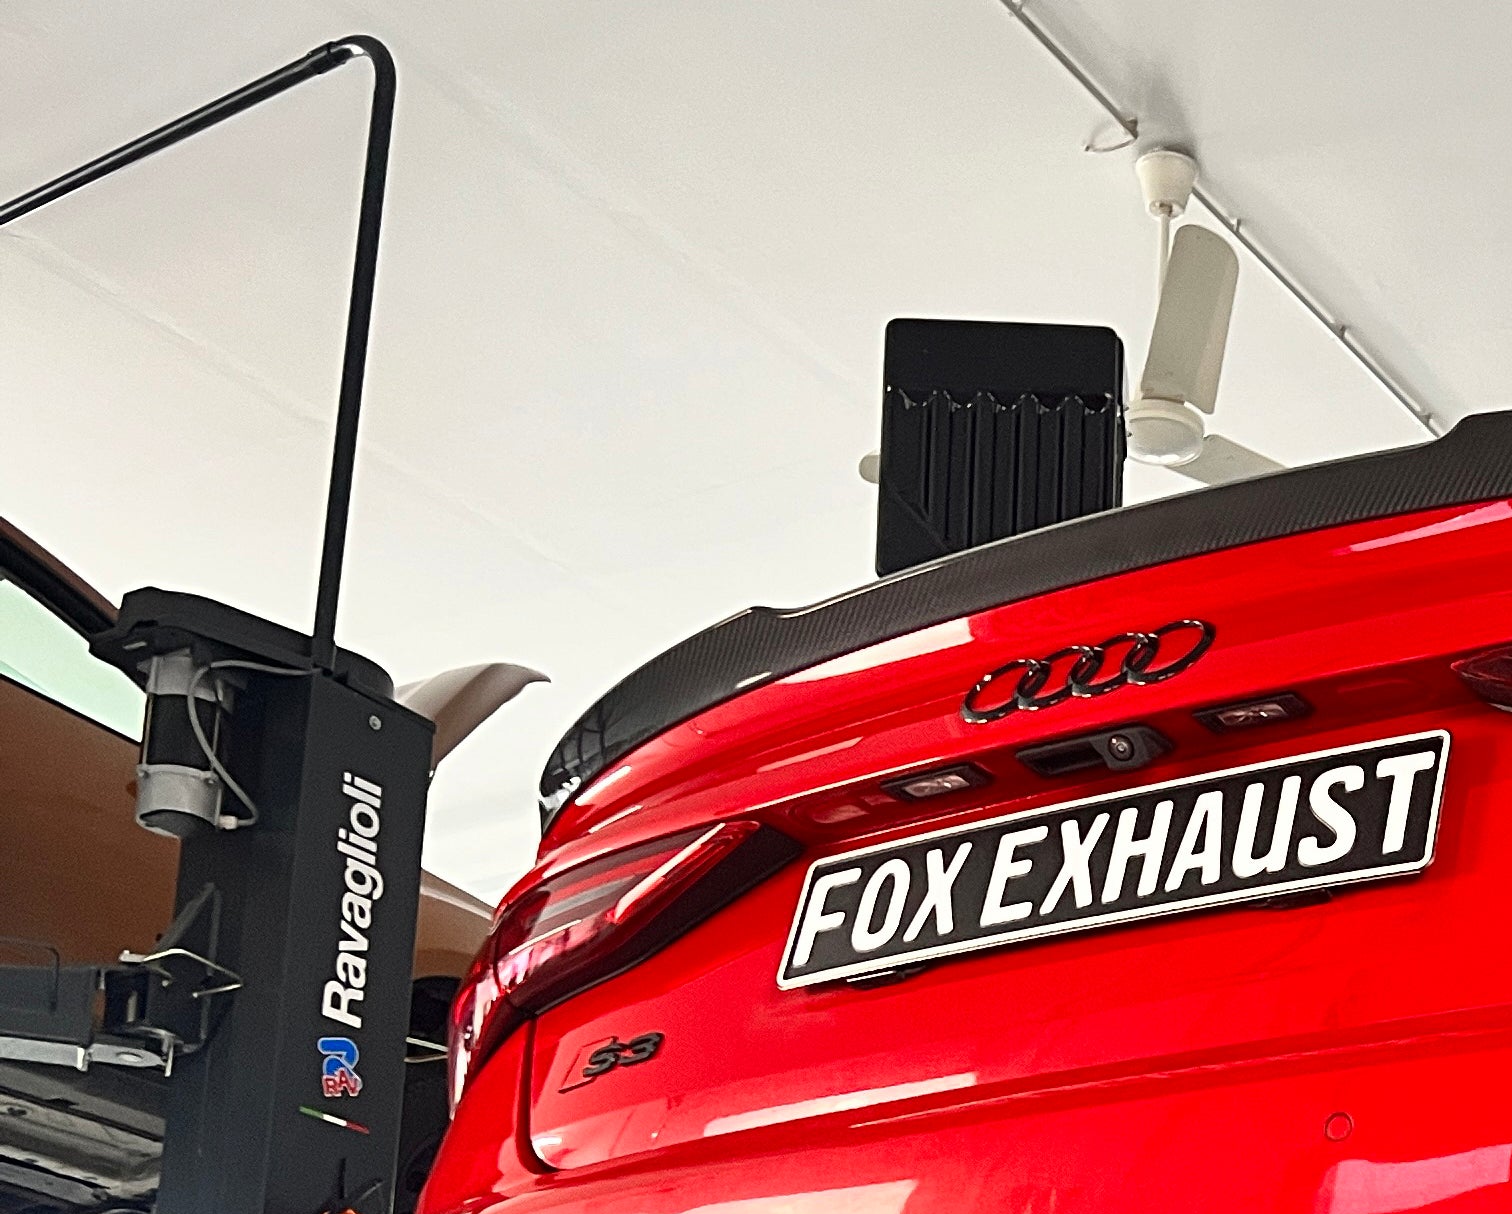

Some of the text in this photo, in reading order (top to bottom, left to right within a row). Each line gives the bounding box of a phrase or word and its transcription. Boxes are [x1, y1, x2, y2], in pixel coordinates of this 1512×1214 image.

[322, 772, 384, 1029] Ravaglioli
[792, 751, 1436, 968] FOX EXHAUST
[581, 1032, 665, 1078] S3
